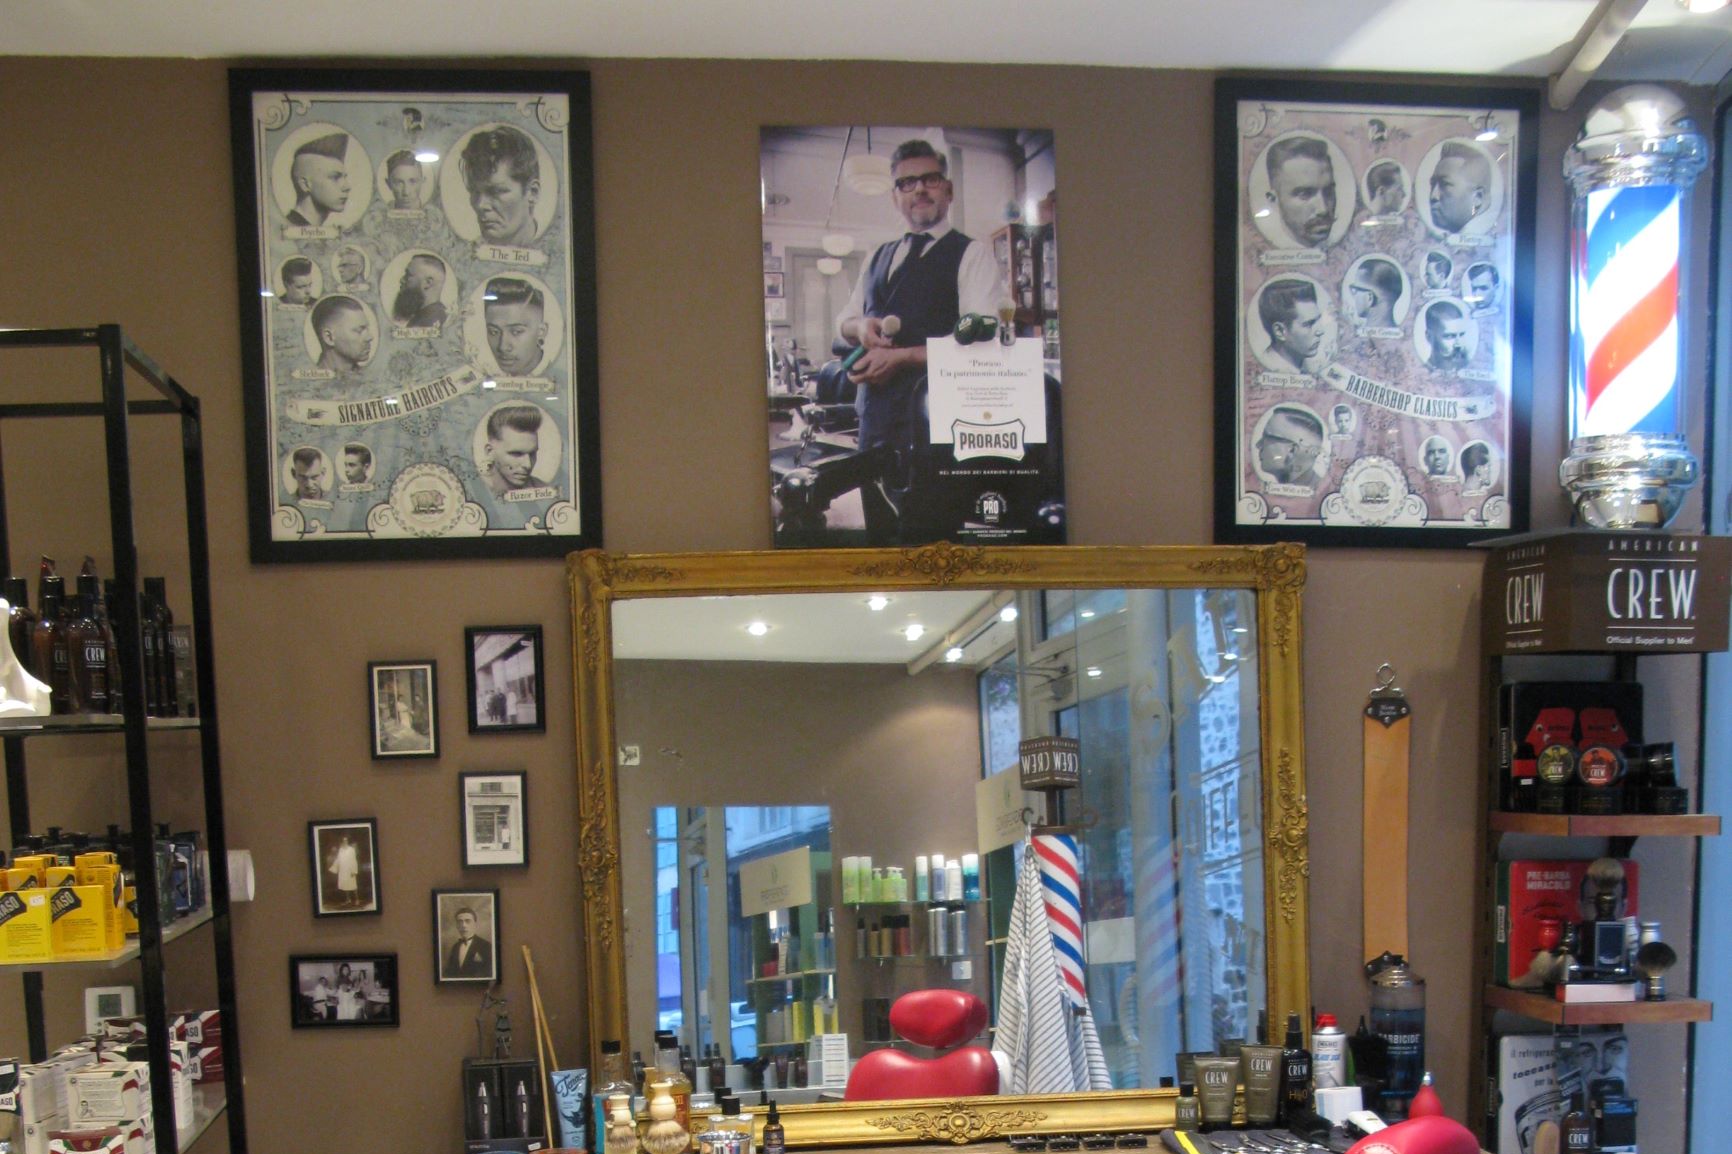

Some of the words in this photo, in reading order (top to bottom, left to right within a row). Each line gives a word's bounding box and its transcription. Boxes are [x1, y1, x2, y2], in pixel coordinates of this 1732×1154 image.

[490, 248, 509, 260] The
[513, 251, 529, 262] Ted
[338, 399, 401, 424] SIGNATURE
[402, 376, 458, 412] HAIRCUTS
[1346, 374, 1412, 411] BARBERSHOP
[1413, 396, 1458, 419] CLASSICS
[960, 432, 1018, 451] PRORASO
[983, 500, 999, 515] PRO
[1609, 540, 1698, 552] AMERICAN
[1506, 573, 1544, 624] CREW
[1607, 568, 1696, 619] CREW
[1607, 635, 1632, 645] Official
[1636, 635, 1665, 646] Supplier
[1667, 636, 1675, 645] to
[85, 647, 105, 662] CREW
[1251, 1059, 1273, 1071] CREW
[1288, 1064, 1308, 1077] CREW
[1205, 1072, 1229, 1084] CREW
[1179, 1108, 1195, 1119] CREW
[1568, 1133, 1589, 1144] CREW
